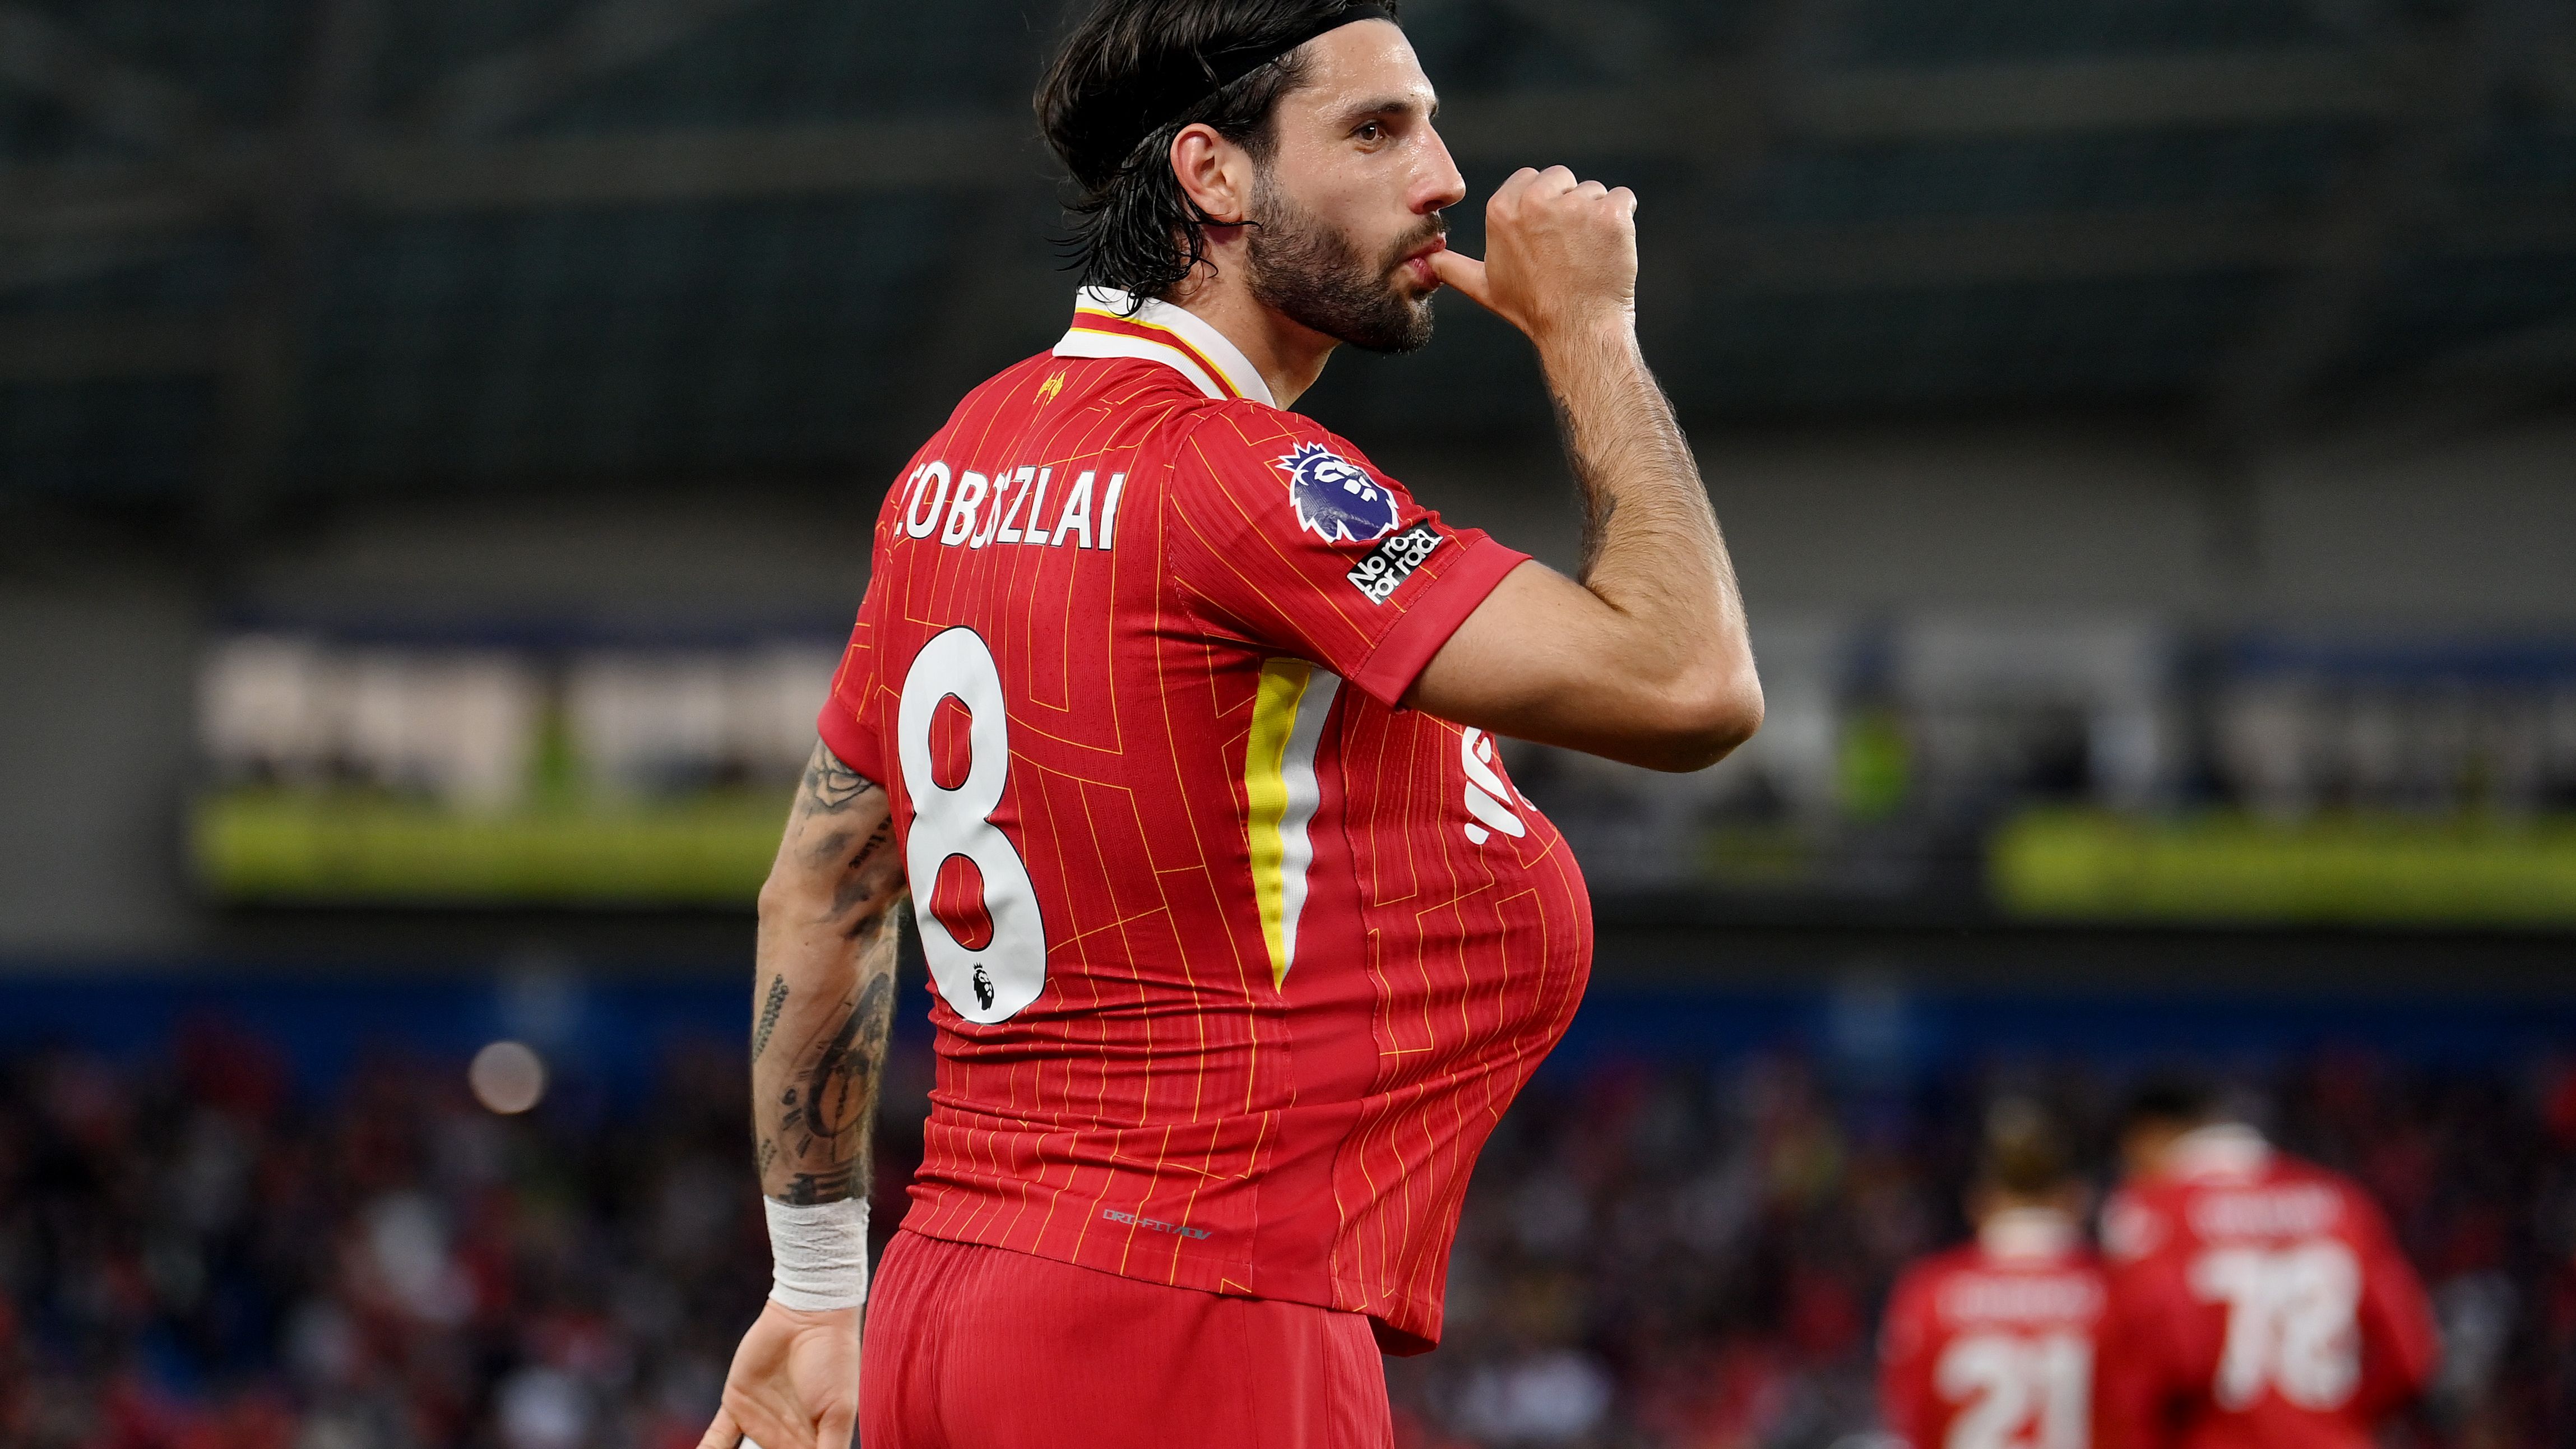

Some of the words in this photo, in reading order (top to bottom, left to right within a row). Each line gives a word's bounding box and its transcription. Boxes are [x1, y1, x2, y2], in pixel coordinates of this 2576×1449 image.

[1346, 555, 1386, 592] No
[1364, 567, 1400, 605] for
[897, 625, 1047, 1025] 8
[1933, 1330, 2094, 1449] 21
